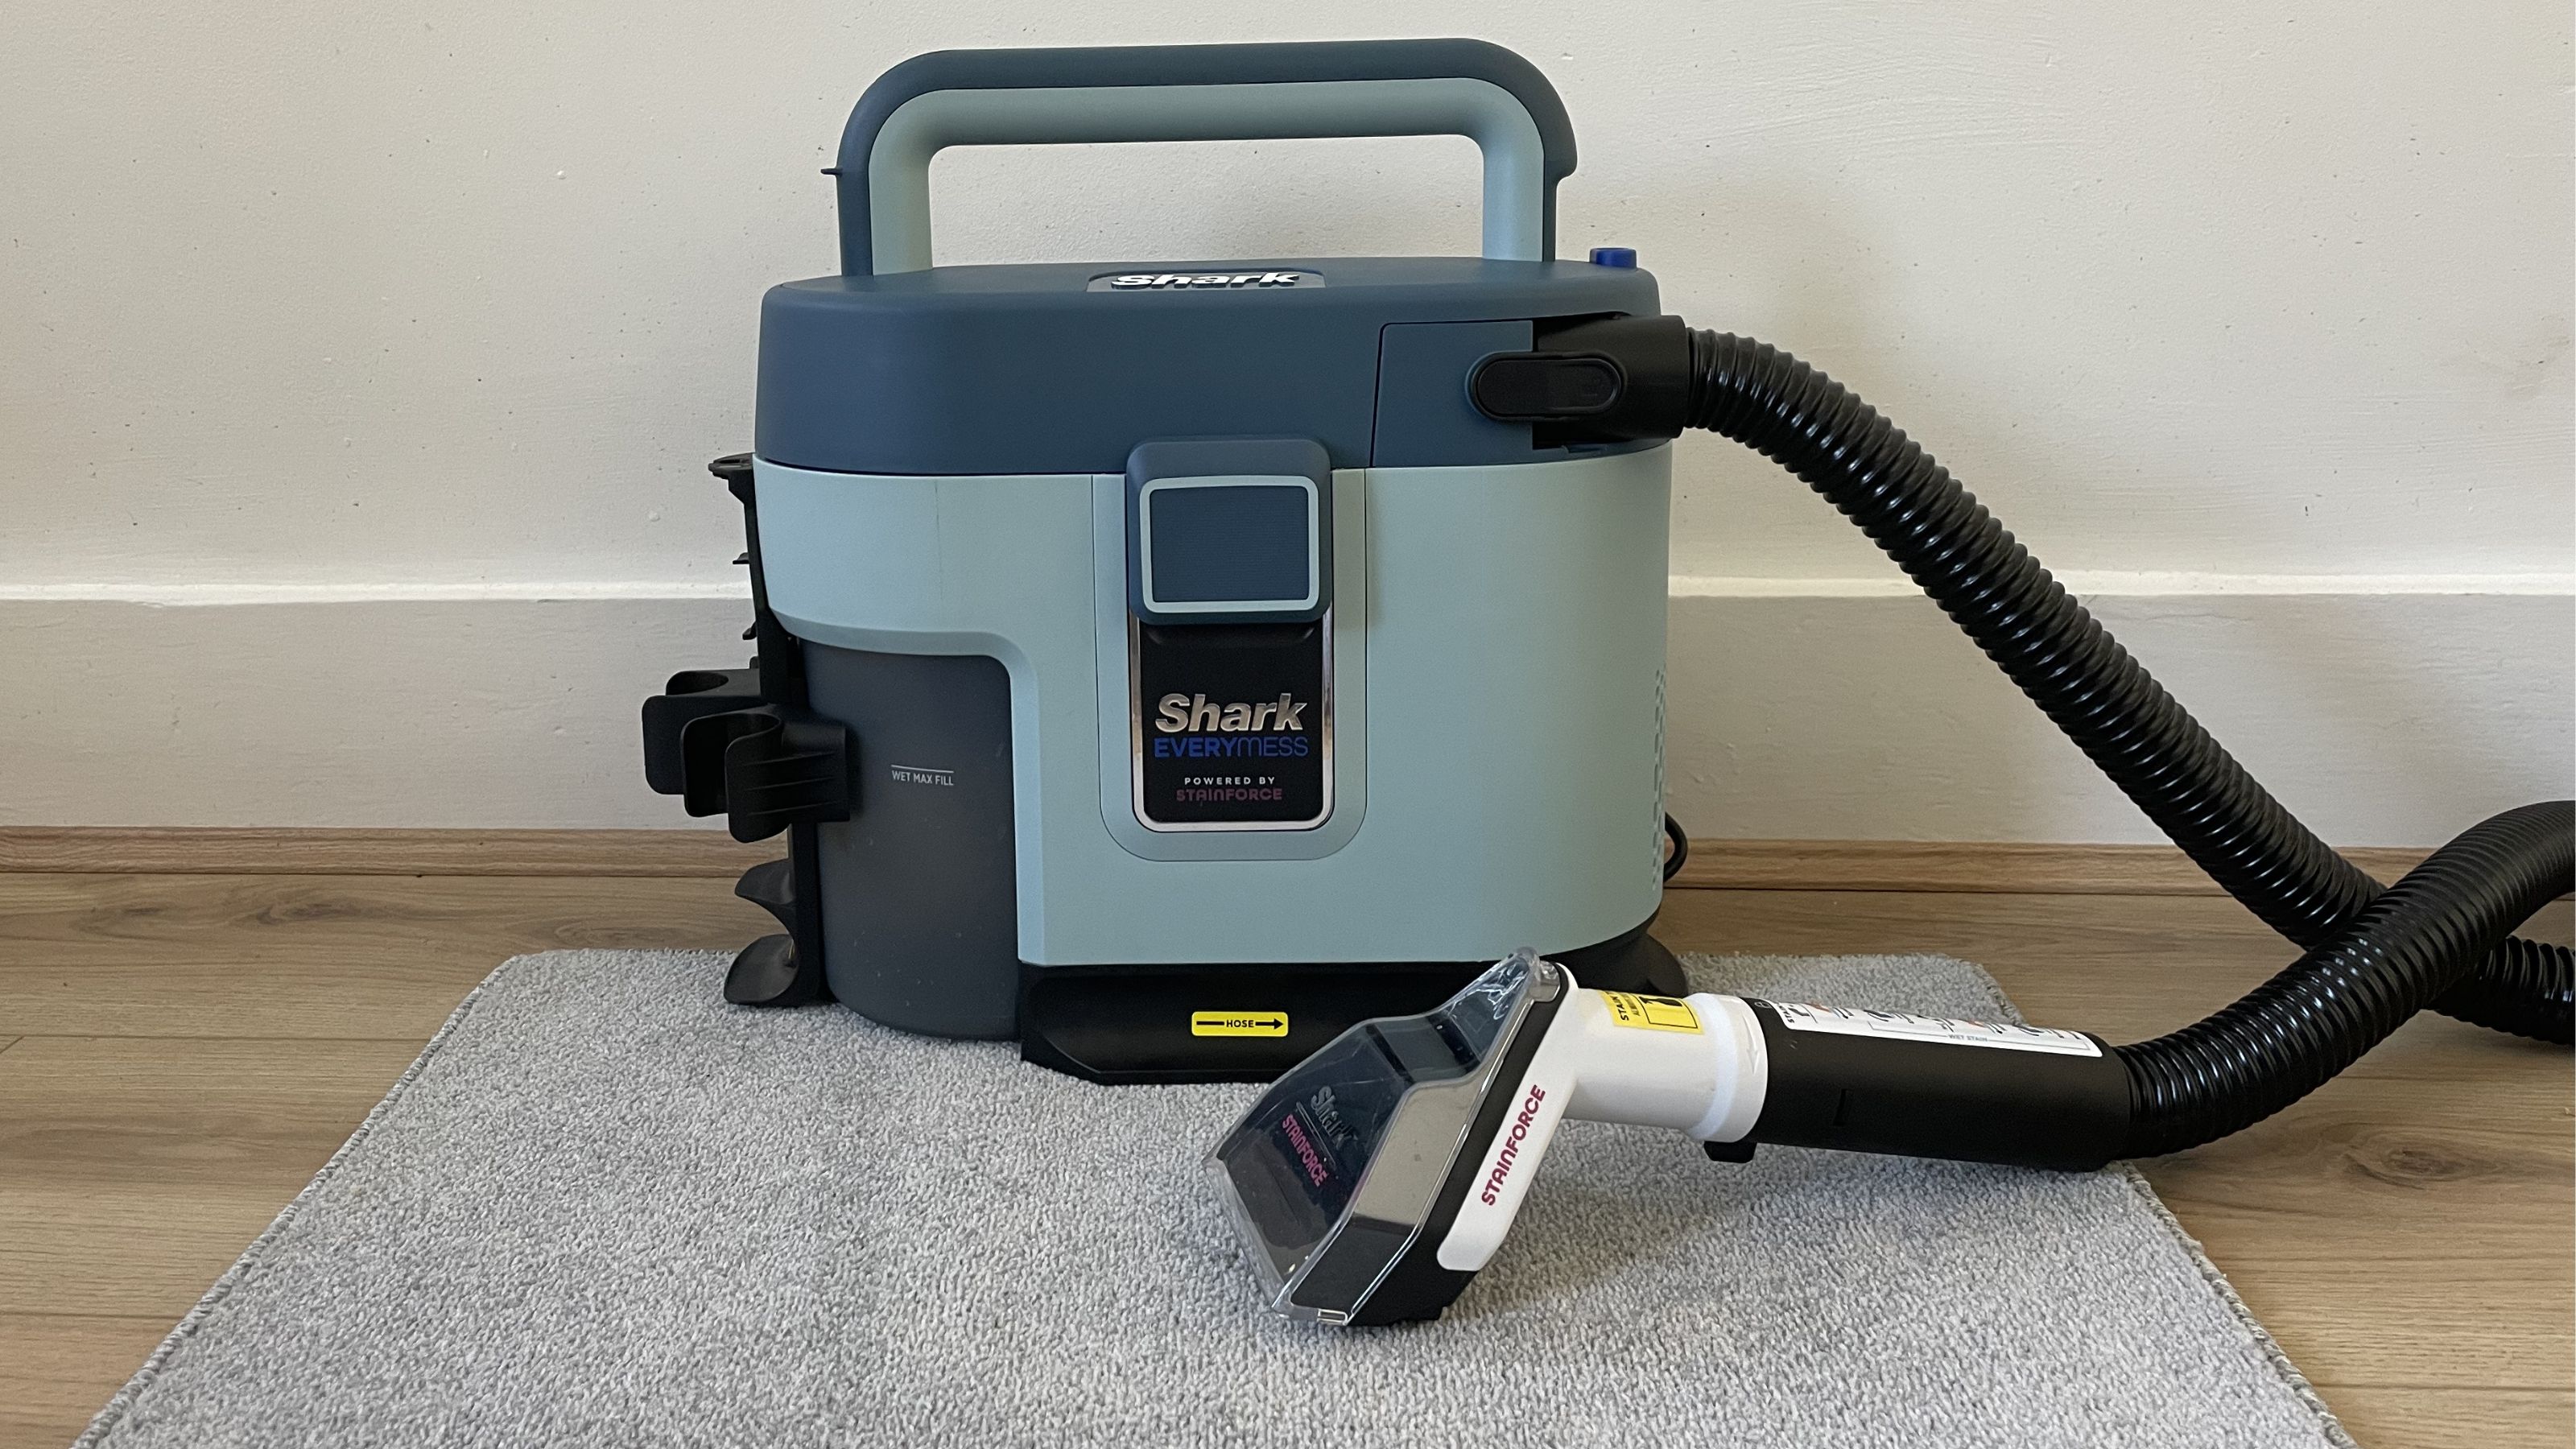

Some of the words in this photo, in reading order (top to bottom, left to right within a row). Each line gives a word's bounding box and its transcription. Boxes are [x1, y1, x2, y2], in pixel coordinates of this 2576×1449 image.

[1111, 272, 1300, 290] Shark
[1155, 693, 1307, 733] Shark
[1154, 736, 1309, 758] EVERYMESS
[892, 770, 910, 781] WET
[914, 773, 933, 783] MAX
[935, 775, 954, 786] FILL
[1184, 777, 1251, 785] POWERED
[1259, 776, 1275, 785] BY
[1176, 788, 1282, 802] STAINFORCE
[1226, 1019, 1255, 1028] HOSE
[1311, 1086, 1358, 1150] Shark
[1282, 1113, 1330, 1187] STAINFORCE
[1481, 1084, 1546, 1206] STAINFORCE
